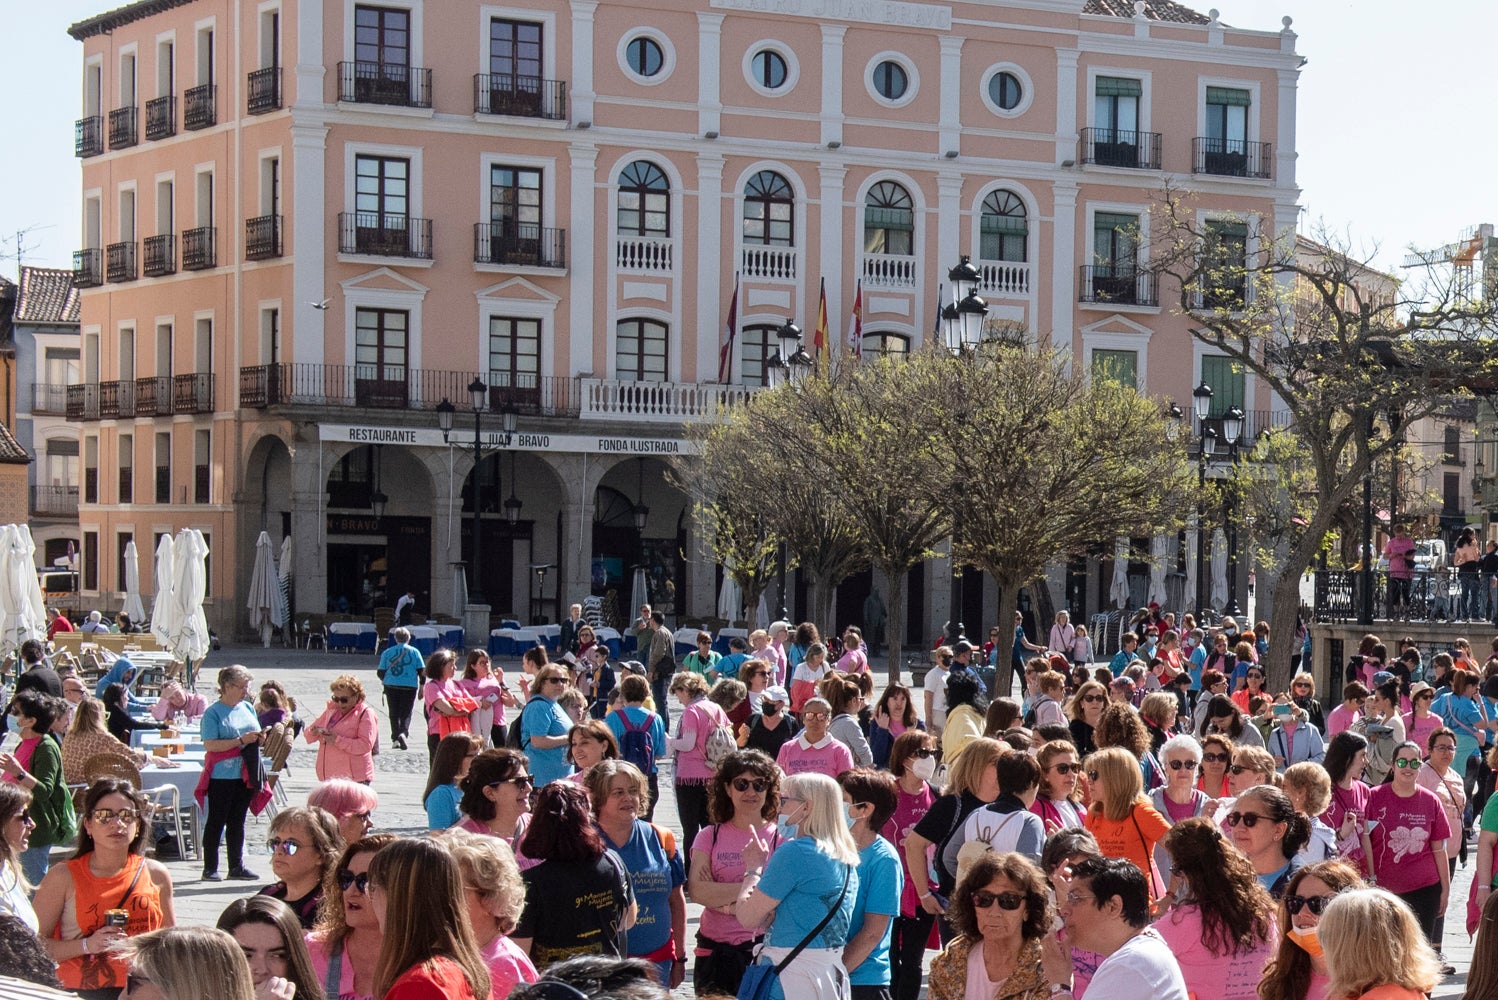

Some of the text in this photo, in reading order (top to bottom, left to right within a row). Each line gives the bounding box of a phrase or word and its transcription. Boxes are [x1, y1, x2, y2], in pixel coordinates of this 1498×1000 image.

[350, 428, 416, 442] RESTAURANTE
[519, 435, 549, 448] BRAVO
[598, 439, 628, 451] FONDA
[630, 440, 679, 453] ILUSTRADA
